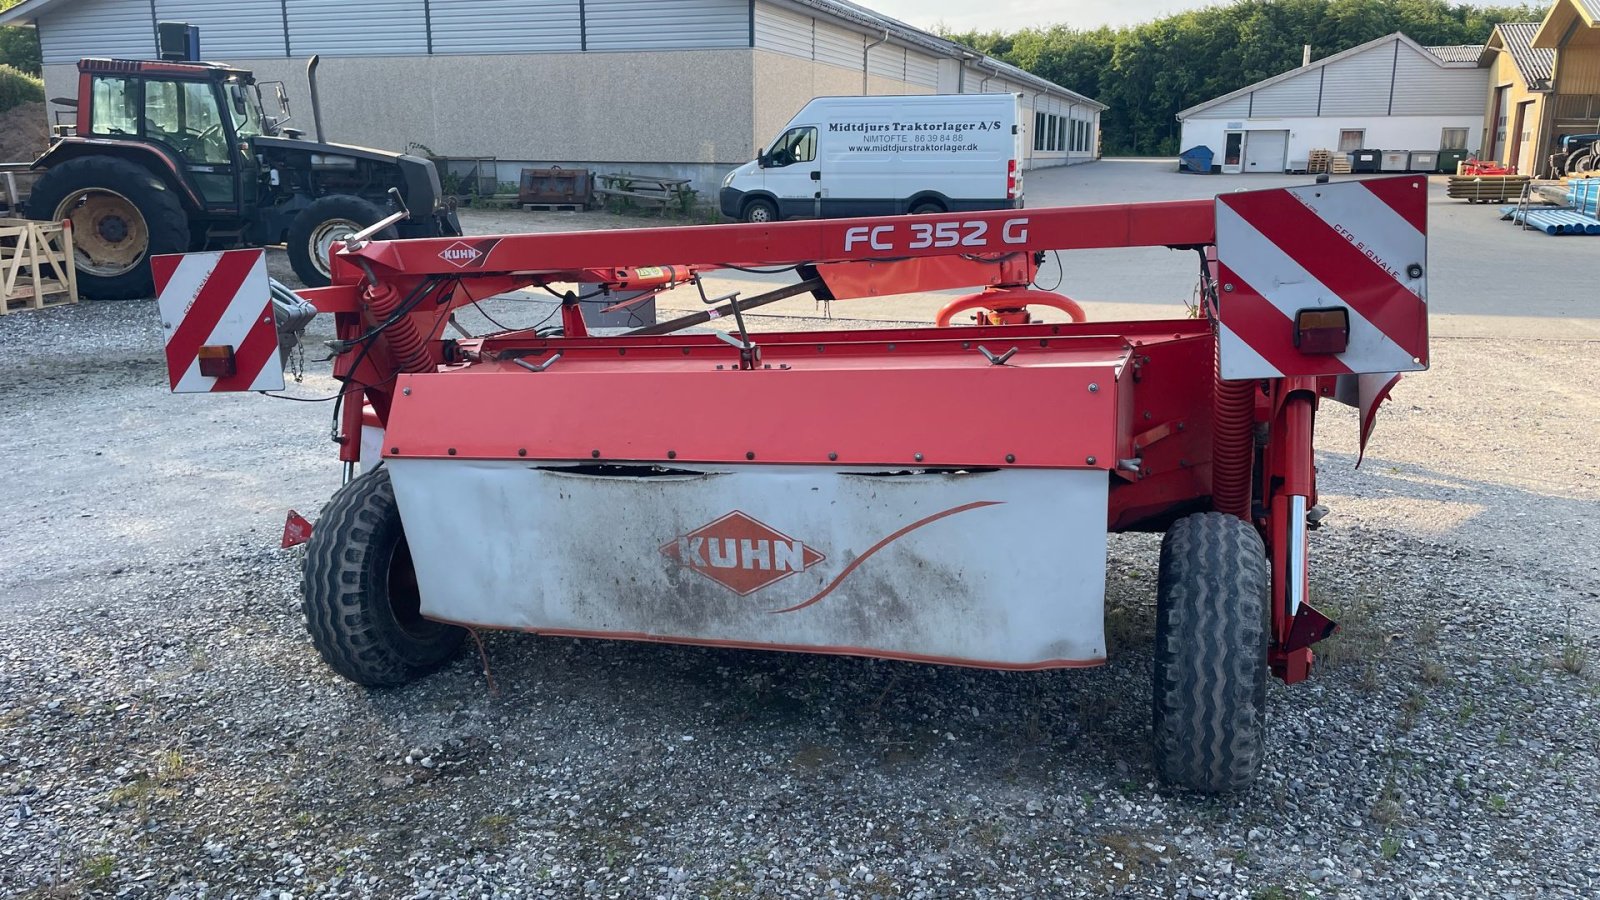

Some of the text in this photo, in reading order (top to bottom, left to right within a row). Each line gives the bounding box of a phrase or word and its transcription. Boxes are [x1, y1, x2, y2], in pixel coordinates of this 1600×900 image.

[829, 121, 1001, 133] Midtdjurs Traktorlager A/S
[849, 144, 978, 152] www.midtdjurstraktorlager.dk
[844, 218, 1028, 252] FC 352 G
[1334, 224, 1354, 242] CFG
[444, 249, 476, 259] KUHN
[677, 536, 805, 572] KUHN
